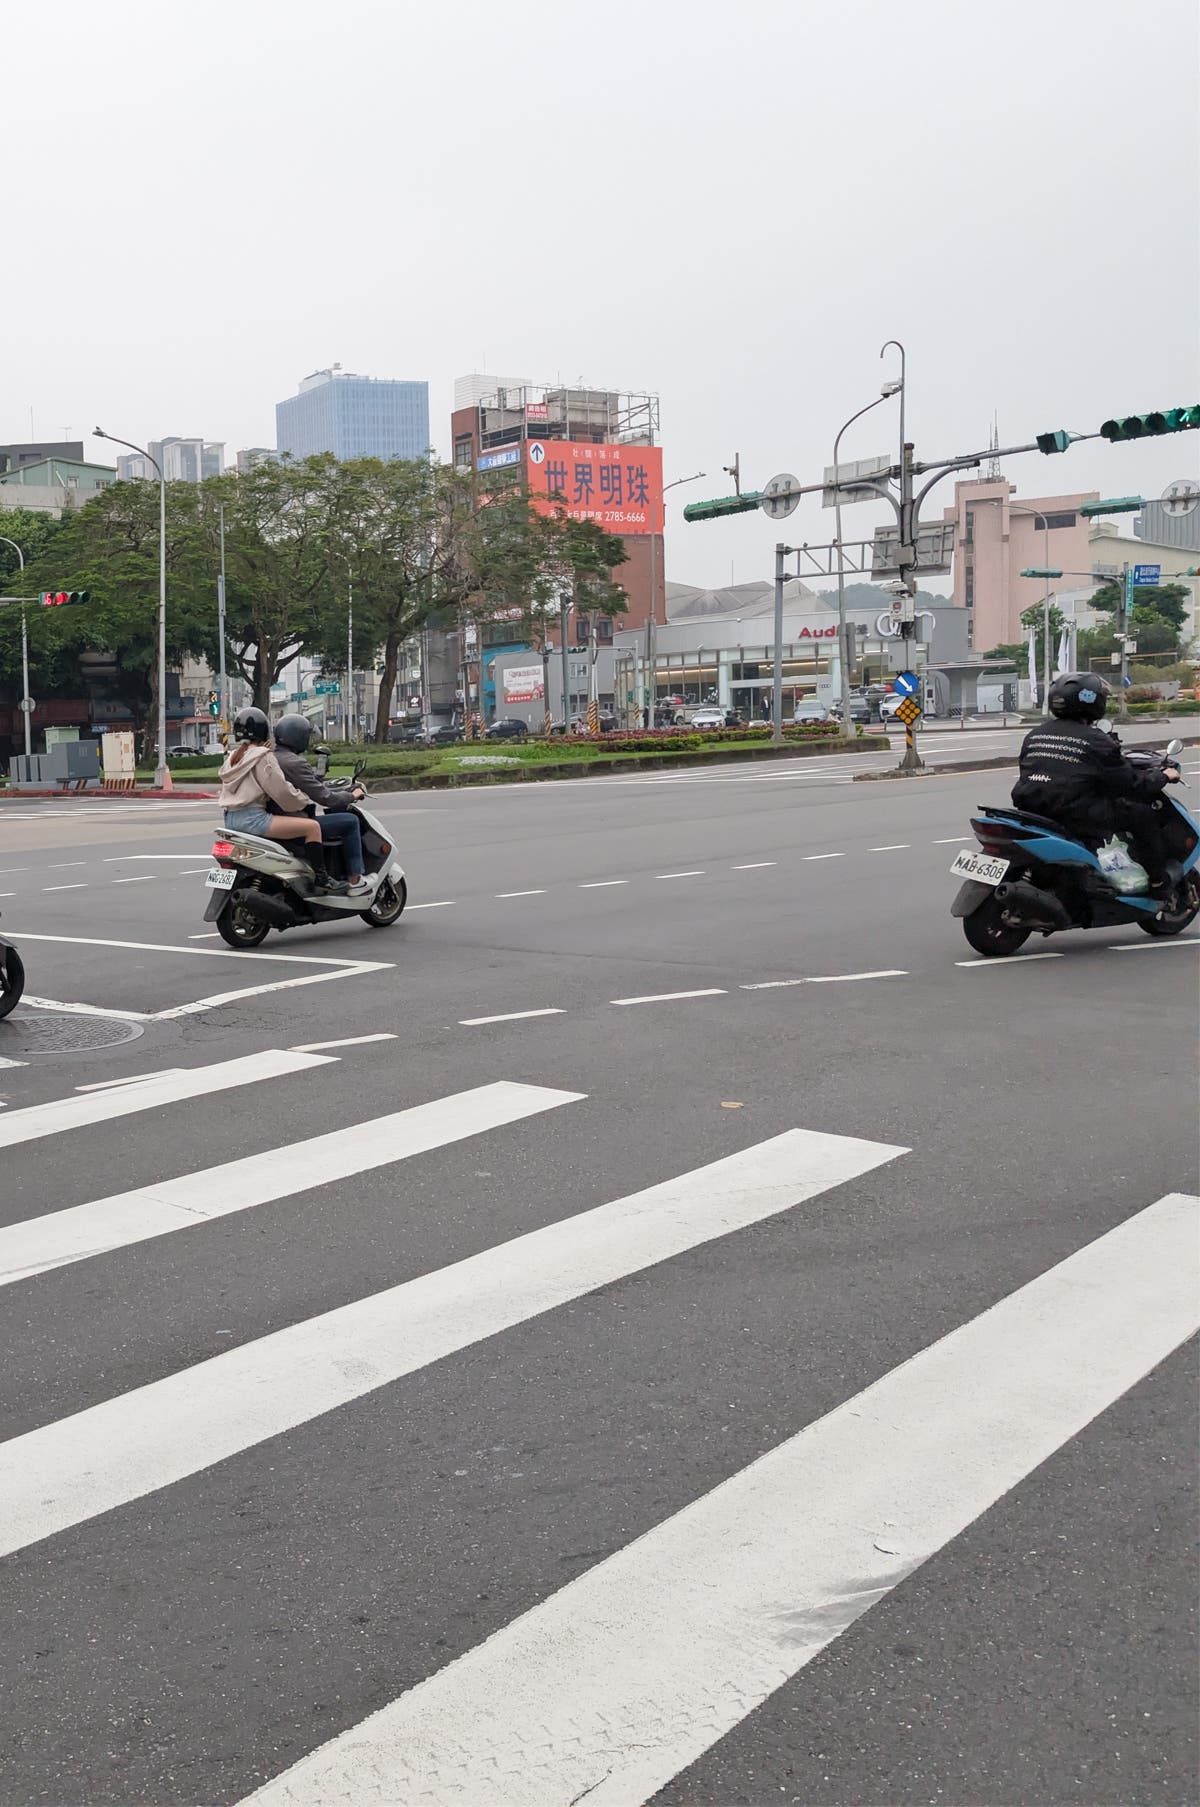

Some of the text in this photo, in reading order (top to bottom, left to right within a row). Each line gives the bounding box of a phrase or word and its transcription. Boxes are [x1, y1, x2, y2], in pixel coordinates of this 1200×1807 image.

[544, 461, 649, 508] 世界明珠
[605, 511, 646, 522] 2785-6666
[799, 625, 838, 639] Aud
